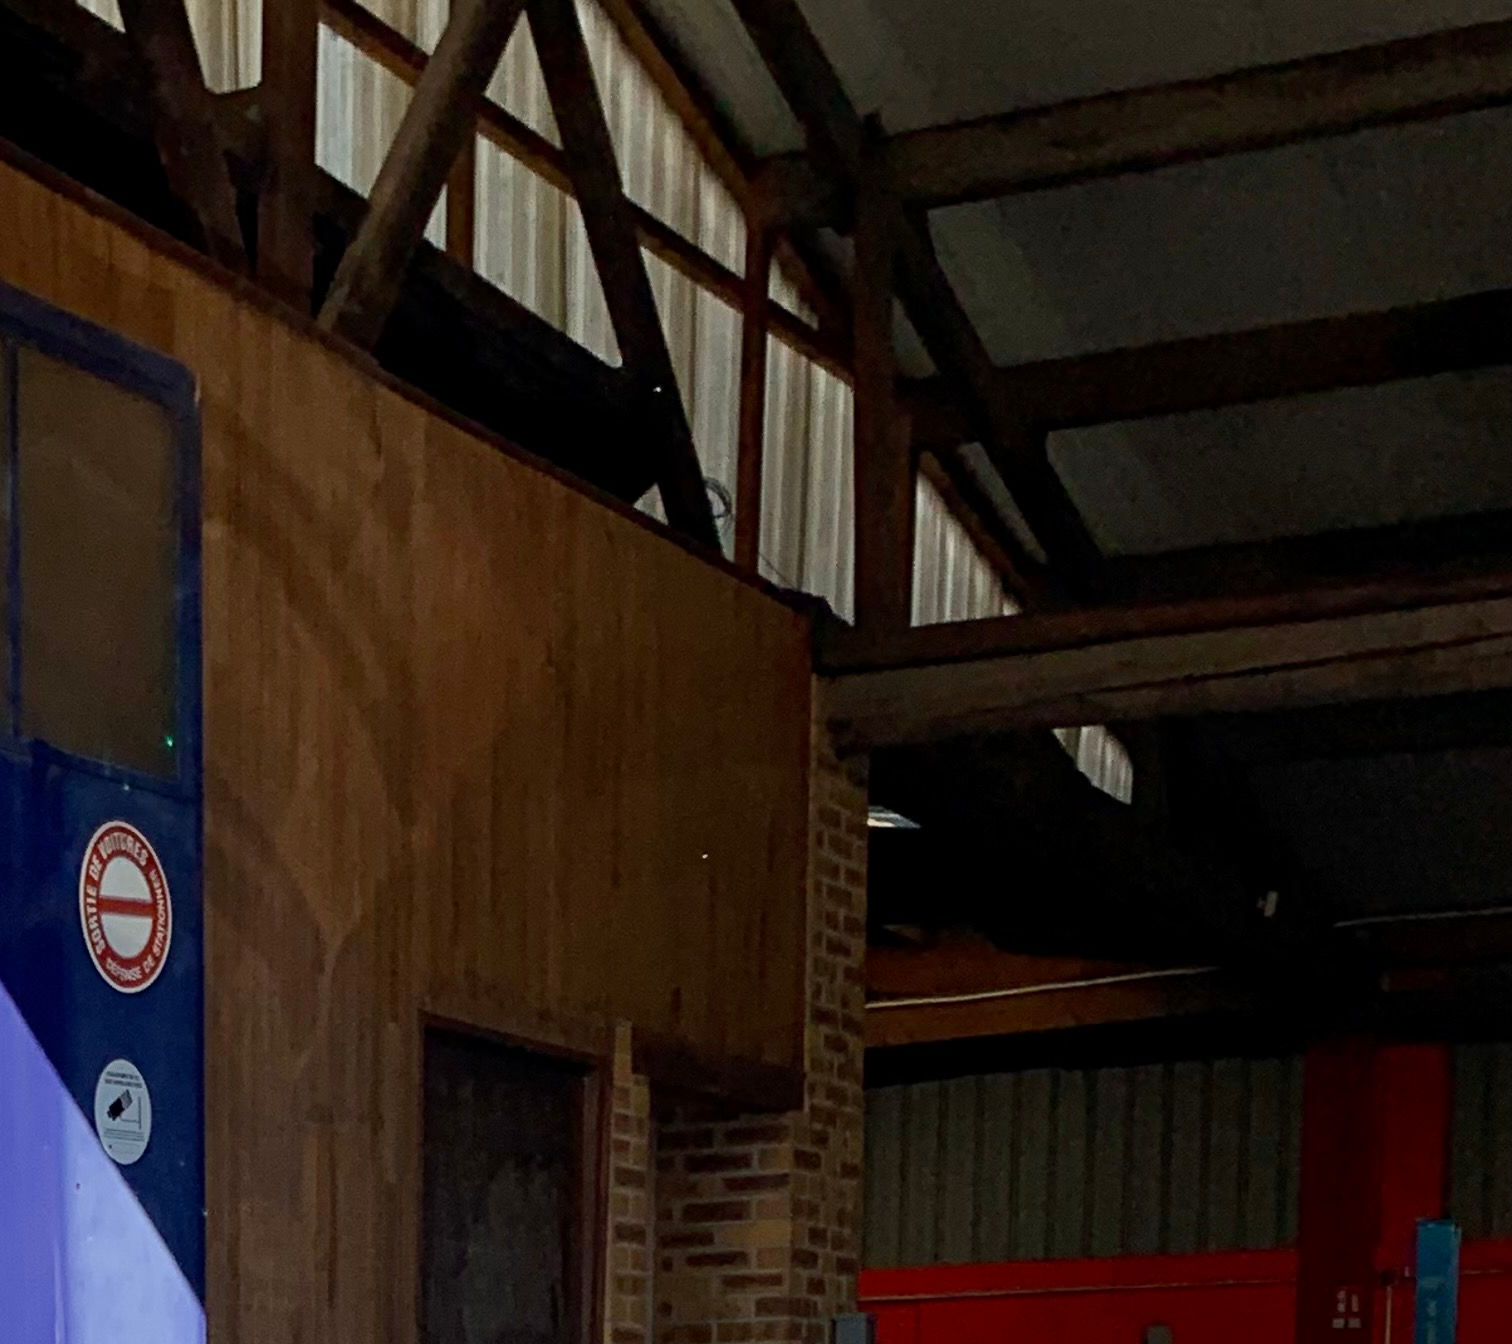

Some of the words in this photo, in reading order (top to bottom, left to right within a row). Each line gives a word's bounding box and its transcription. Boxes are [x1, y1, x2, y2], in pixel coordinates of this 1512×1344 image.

[97, 832, 149, 867] VOITURES
[89, 855, 103, 881] DE
[86, 887, 107, 955] SORTIE
[143, 954, 156, 973] DE
